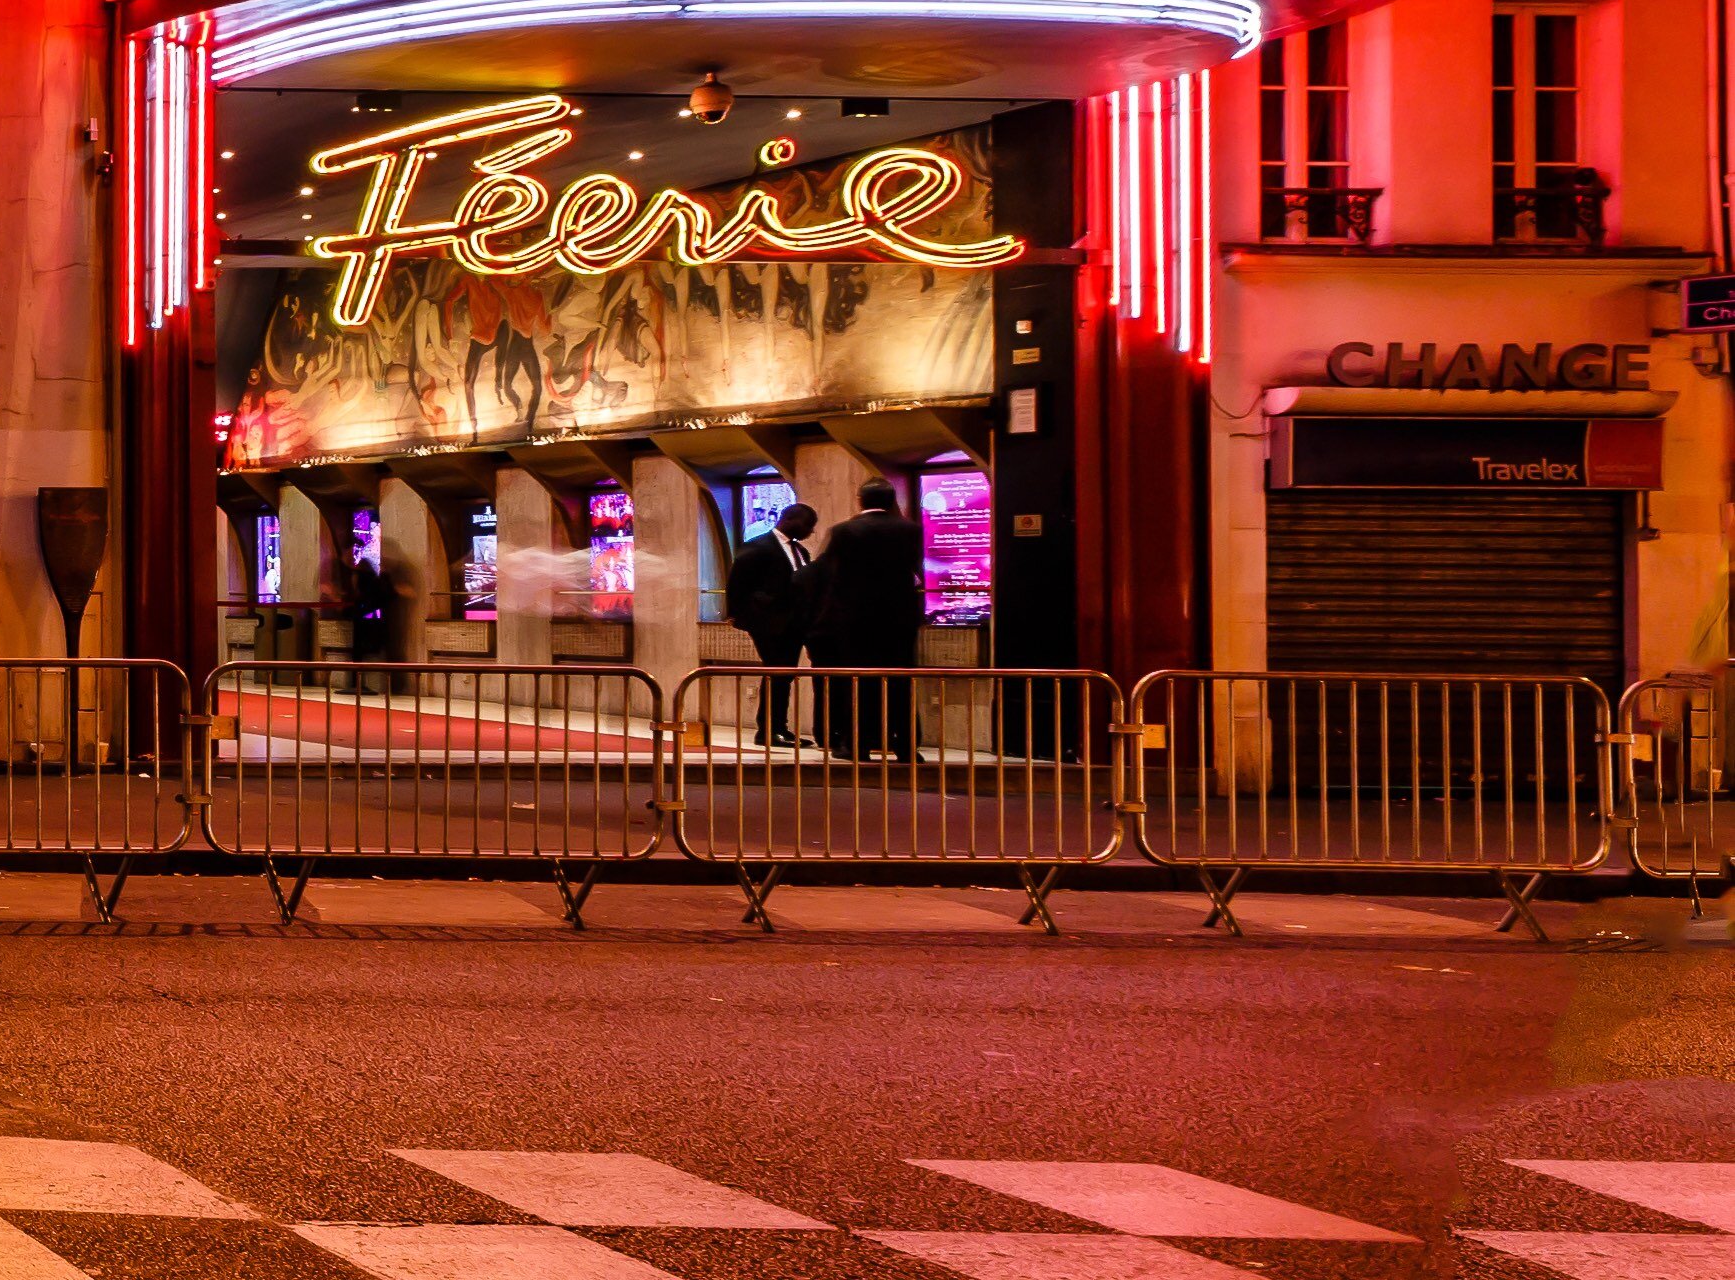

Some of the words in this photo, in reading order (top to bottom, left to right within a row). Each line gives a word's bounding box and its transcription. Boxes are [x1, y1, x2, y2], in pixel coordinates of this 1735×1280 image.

[311, 95, 1025, 326] Féerie
[1327, 341, 1651, 391] CHANGE
[1472, 457, 1578, 481] Travelex
